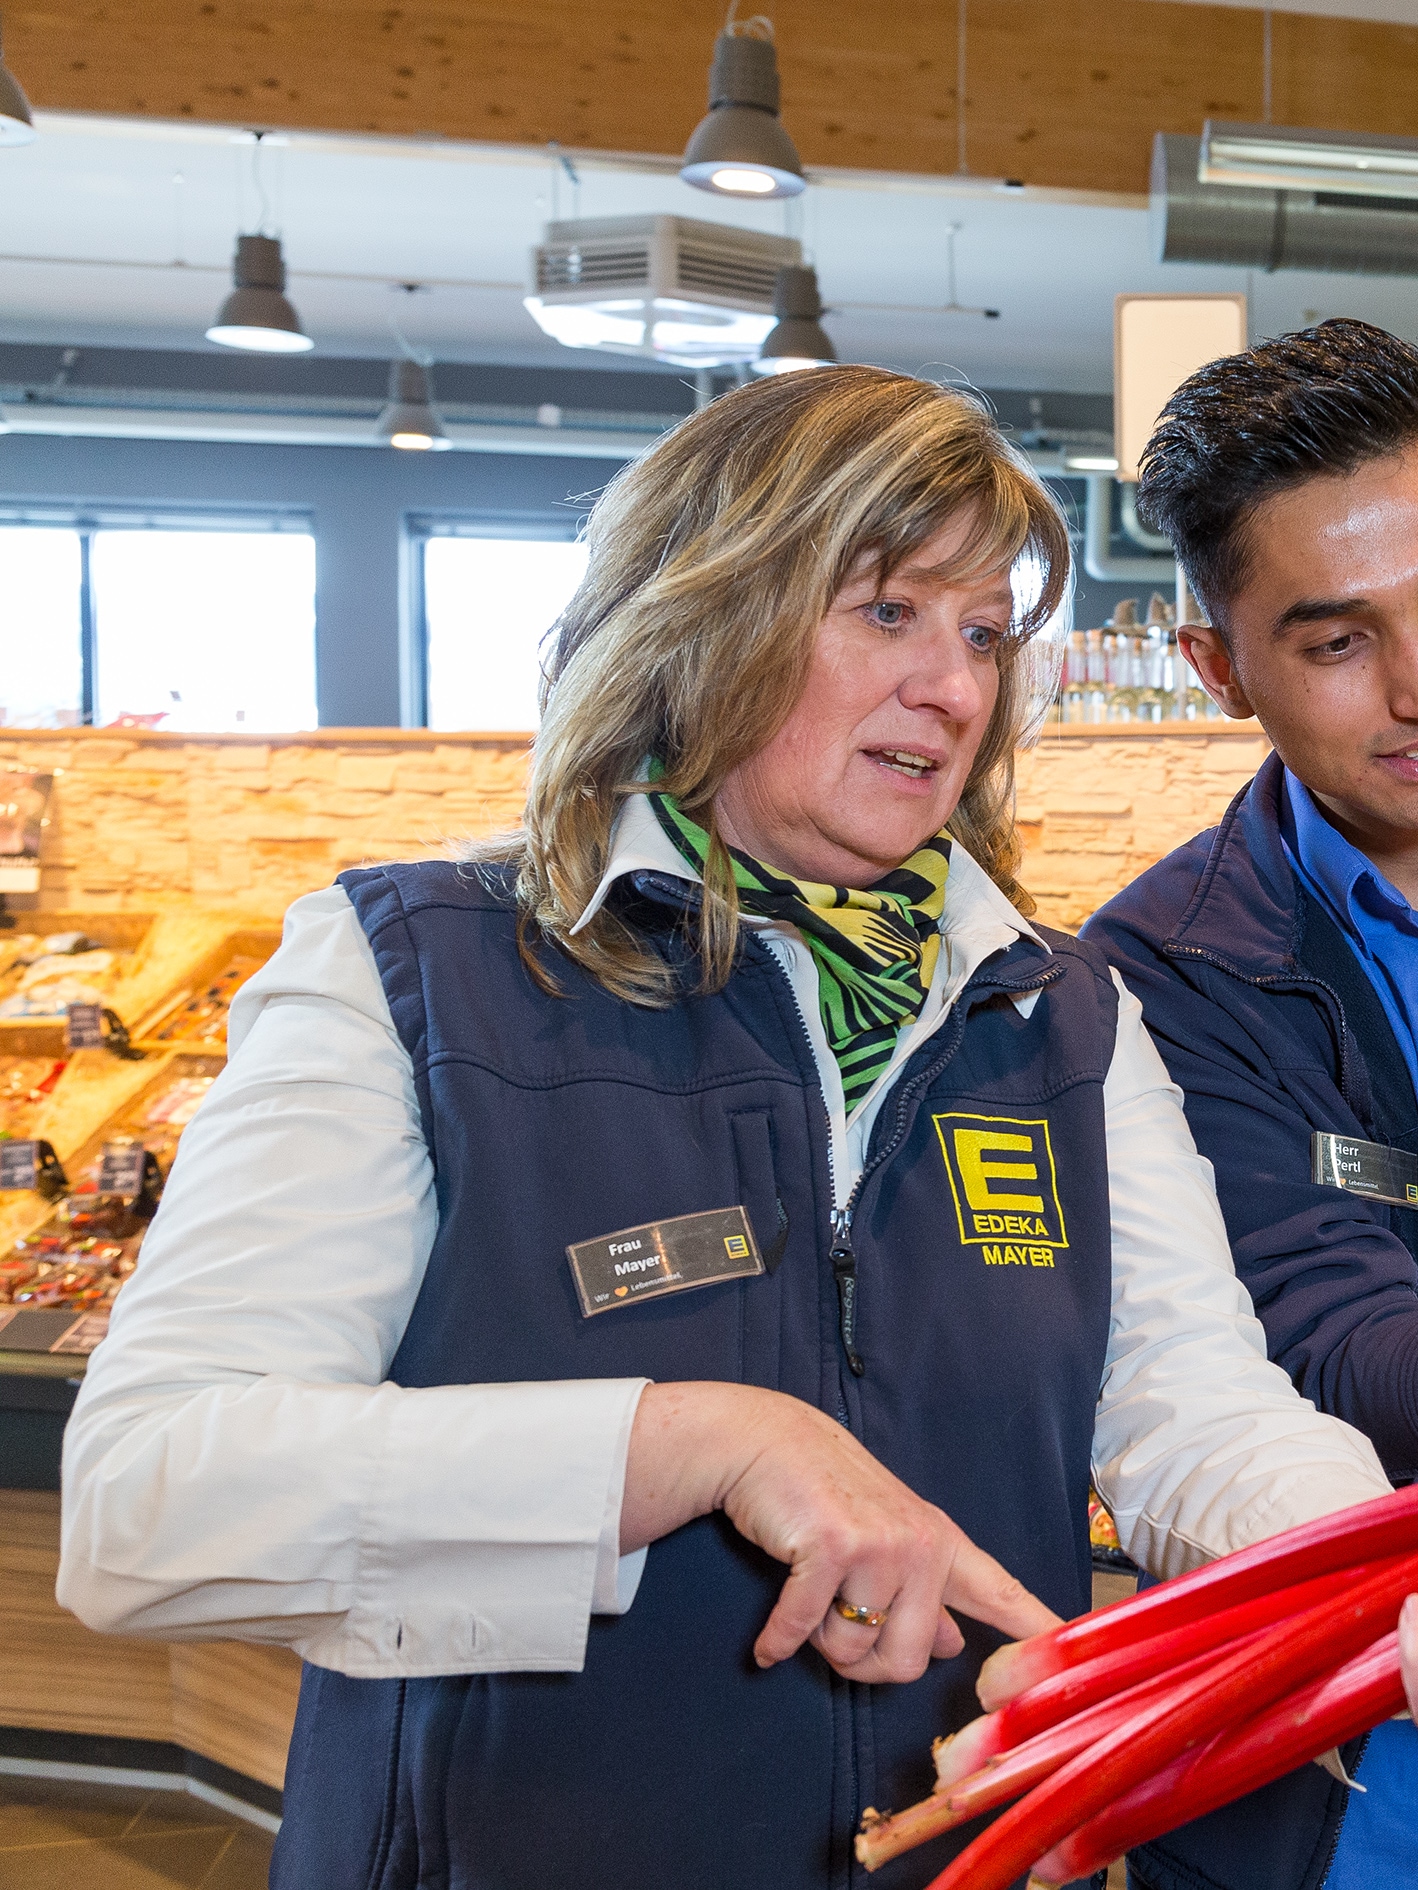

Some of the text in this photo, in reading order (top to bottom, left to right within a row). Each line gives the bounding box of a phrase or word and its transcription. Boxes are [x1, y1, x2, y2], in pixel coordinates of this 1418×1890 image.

[1334, 1143, 1359, 1156] Herr
[953, 1128, 1044, 1213] E
[1336, 1159, 1361, 1173] Pertl
[972, 1214, 1049, 1236] EDEKA
[608, 1239, 642, 1257] Frau
[982, 1245, 1055, 1268] MAYER
[614, 1255, 661, 1276] Mayer
[594, 1293, 610, 1303] Wir
[843, 1276, 855, 1345] Regatta
